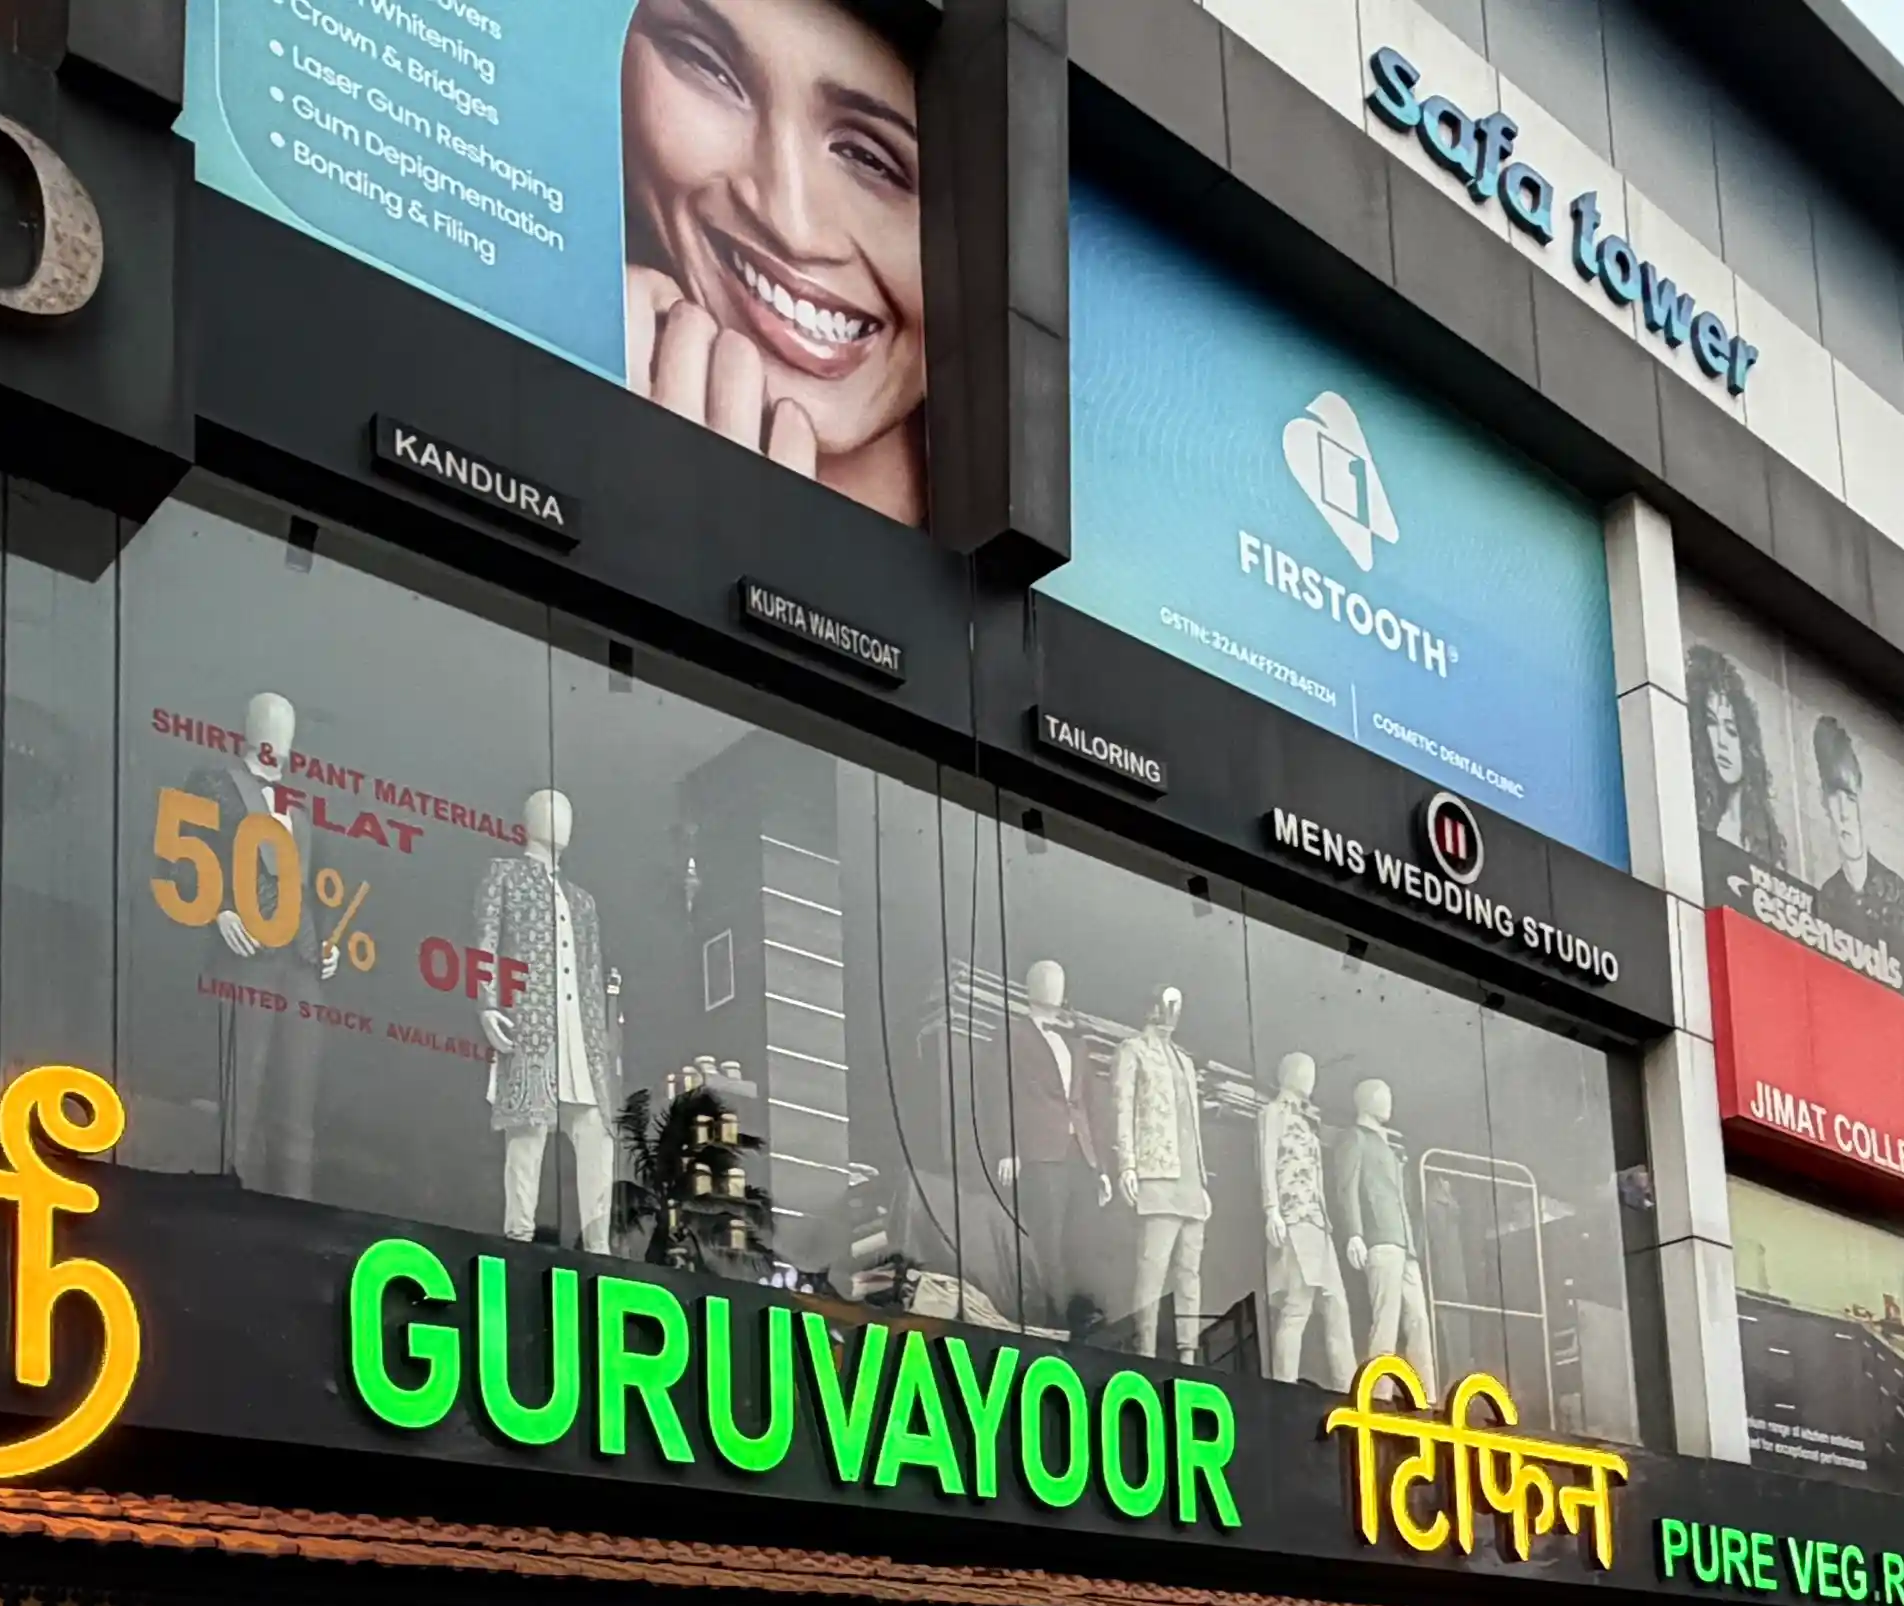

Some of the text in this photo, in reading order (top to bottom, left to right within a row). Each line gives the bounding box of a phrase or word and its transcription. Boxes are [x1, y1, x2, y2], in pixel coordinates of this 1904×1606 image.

[291, 0, 499, 125] Crown & Bridges
[292, 95, 563, 251] Gum Depigmentation
[293, 45, 563, 213] Laser Gum Reshaping
[294, 140, 495, 265] Bonding & Filing
[1570, 191, 1759, 396] tower
[395, 428, 564, 525] KANDURA
[750, 586, 901, 671] KURTA WAISTCOAT
[1238, 530, 1448, 677] FIRSTOOTH
[151, 708, 527, 847] SHIRT & PANT MATERIALS
[1044, 715, 1160, 782] TAILORING
[1373, 712, 1438, 757] COSMETIC
[273, 783, 424, 854] FLAT
[1274, 806, 1619, 982] MENS WEDDING STUDIO
[1752, 888, 1903, 989] essensuals
[198, 974, 497, 1064] LIMITED STOCK AVAILABLE
[418, 936, 530, 1008] OFF
[1750, 1080, 1827, 1141] JIMAT
[349, 1237, 1242, 1527] GURUVAYOOR
[1326, 1354, 1629, 1571] टिफिन
[1661, 1518, 1778, 1590] PURE
